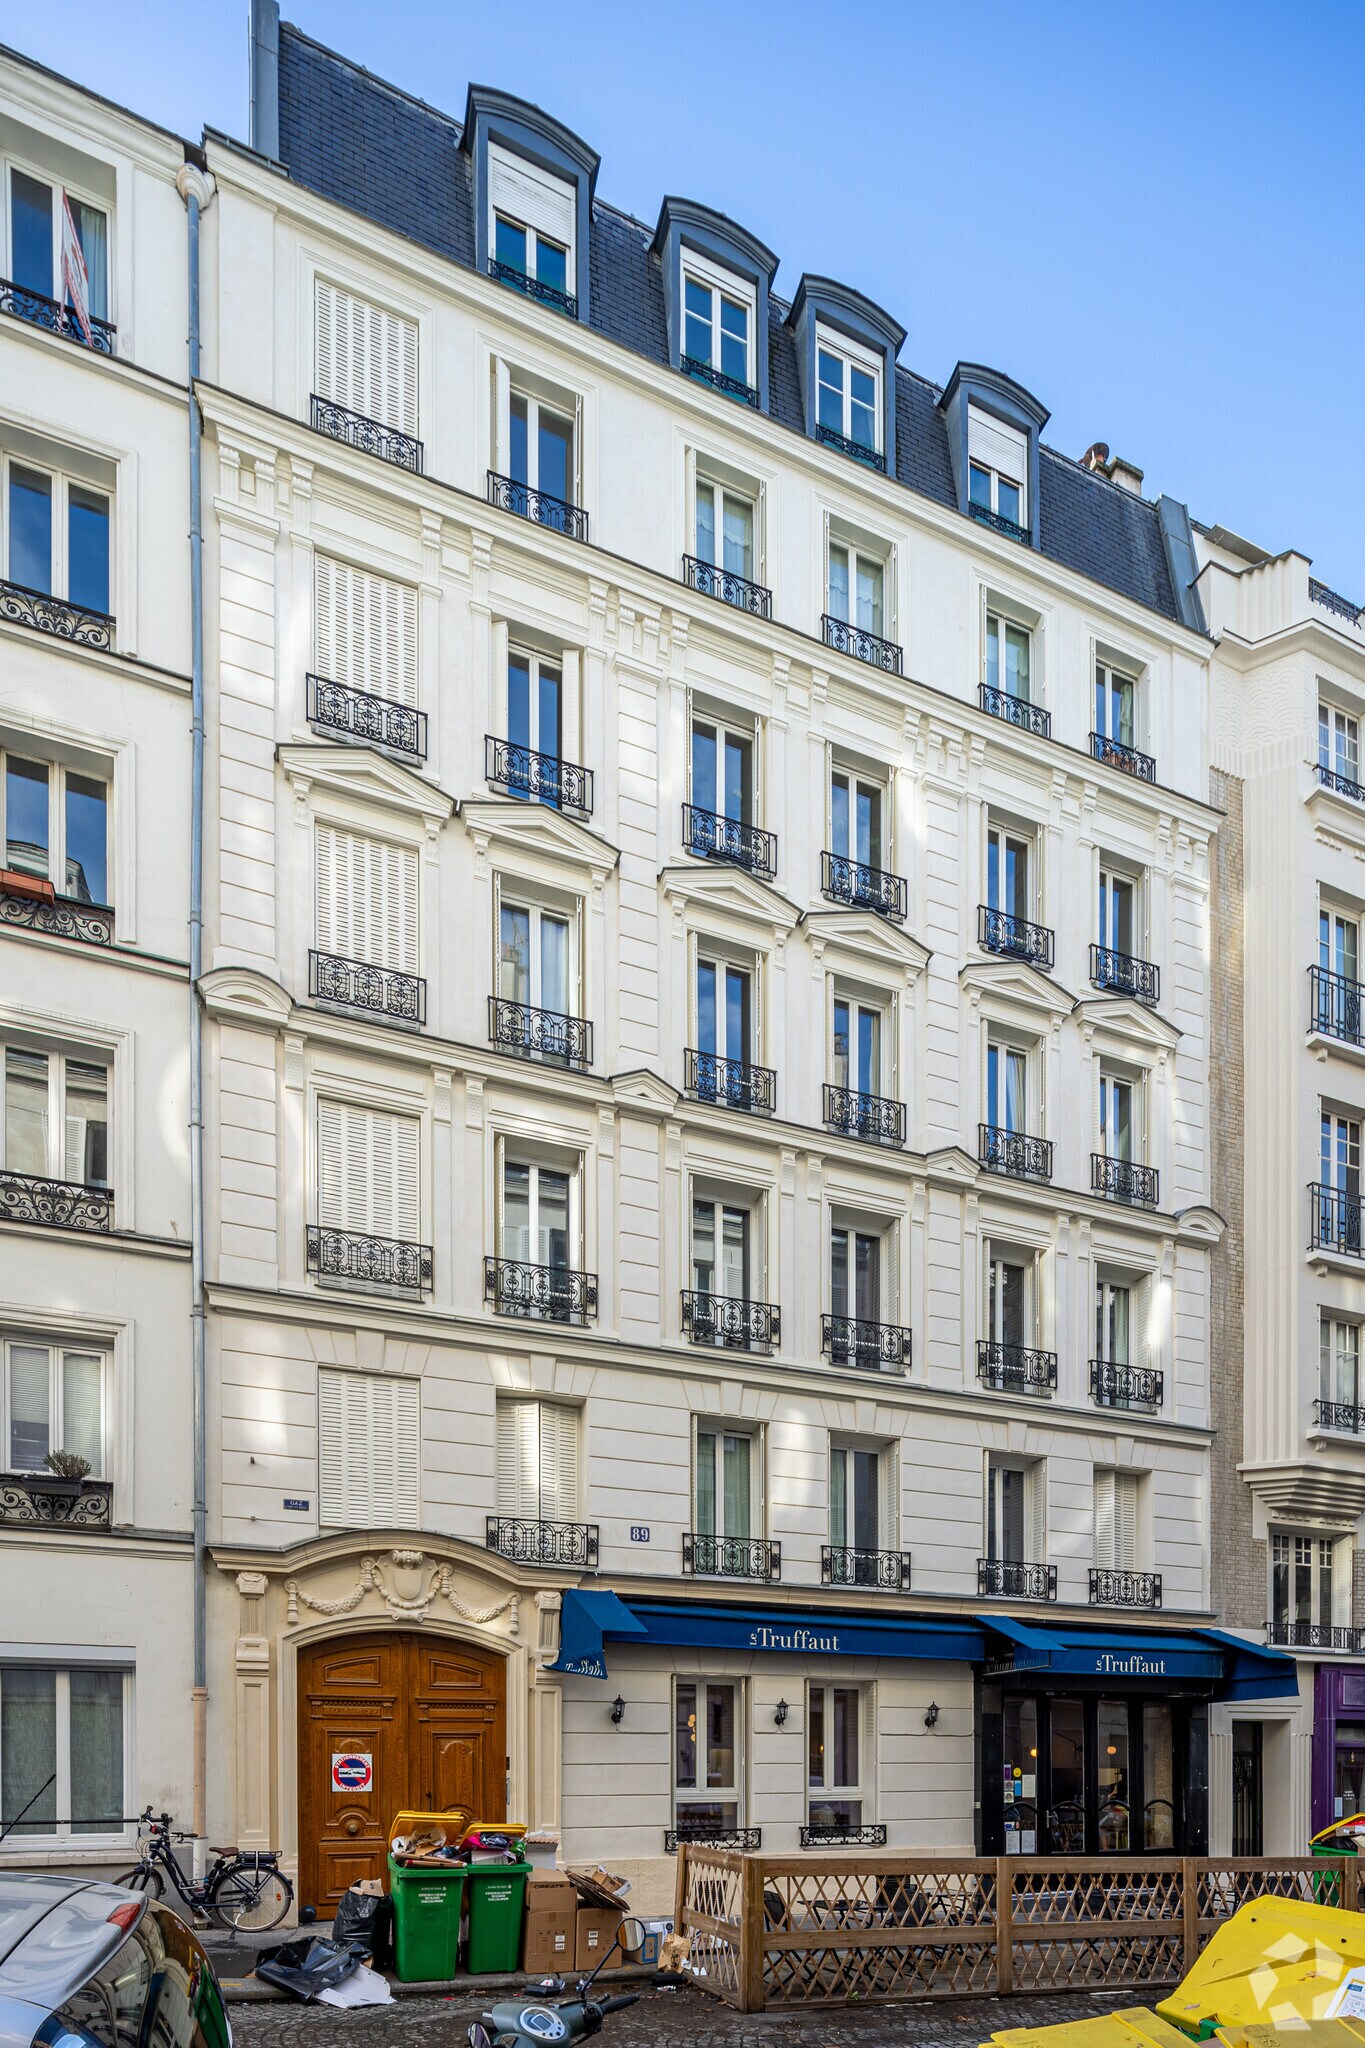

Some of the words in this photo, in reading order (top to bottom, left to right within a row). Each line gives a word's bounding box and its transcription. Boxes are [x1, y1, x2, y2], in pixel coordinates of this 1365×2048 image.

[632, 1527, 649, 1541] 89
[757, 1627, 840, 1651] Truffaut
[1101, 1654, 1166, 1674] Truffaut
